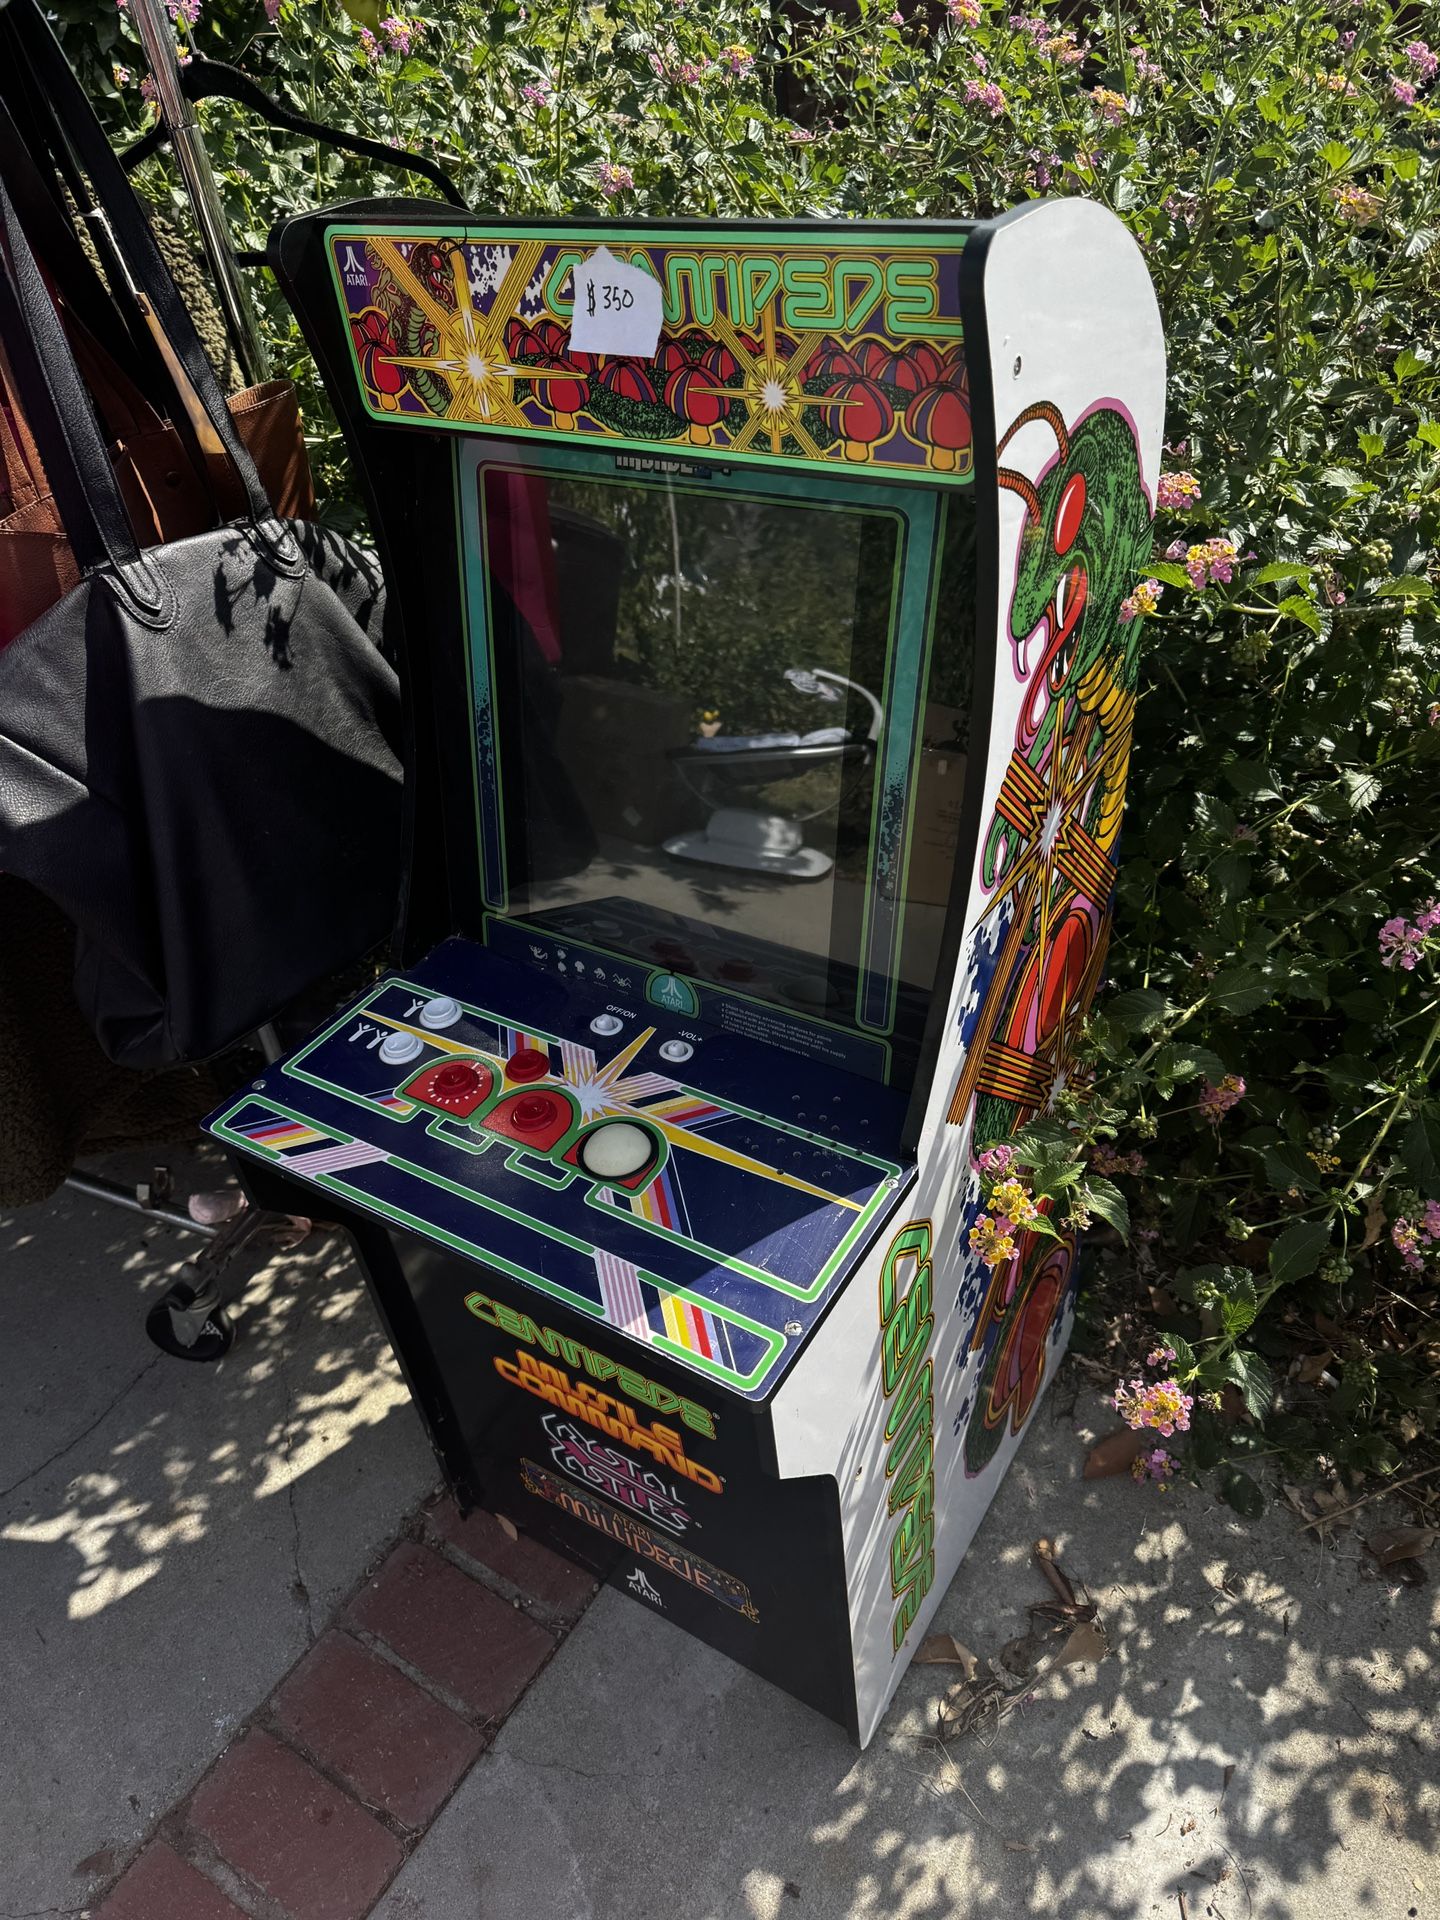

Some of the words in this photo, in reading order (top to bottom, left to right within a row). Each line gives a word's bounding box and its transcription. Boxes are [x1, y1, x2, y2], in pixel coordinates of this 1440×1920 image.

[346, 273, 370, 287] ATARI
[606, 1004, 637, 1019] OFF/ON
[661, 994, 683, 1009] ATARI
[515, 1349, 684, 1454] MISSILE
[879, 1217, 936, 1653] CENTIPEDE
[551, 1446, 688, 1537] CASTLES
[612, 1512, 652, 1542] ATARI
[628, 1581, 662, 1607] ATARI
